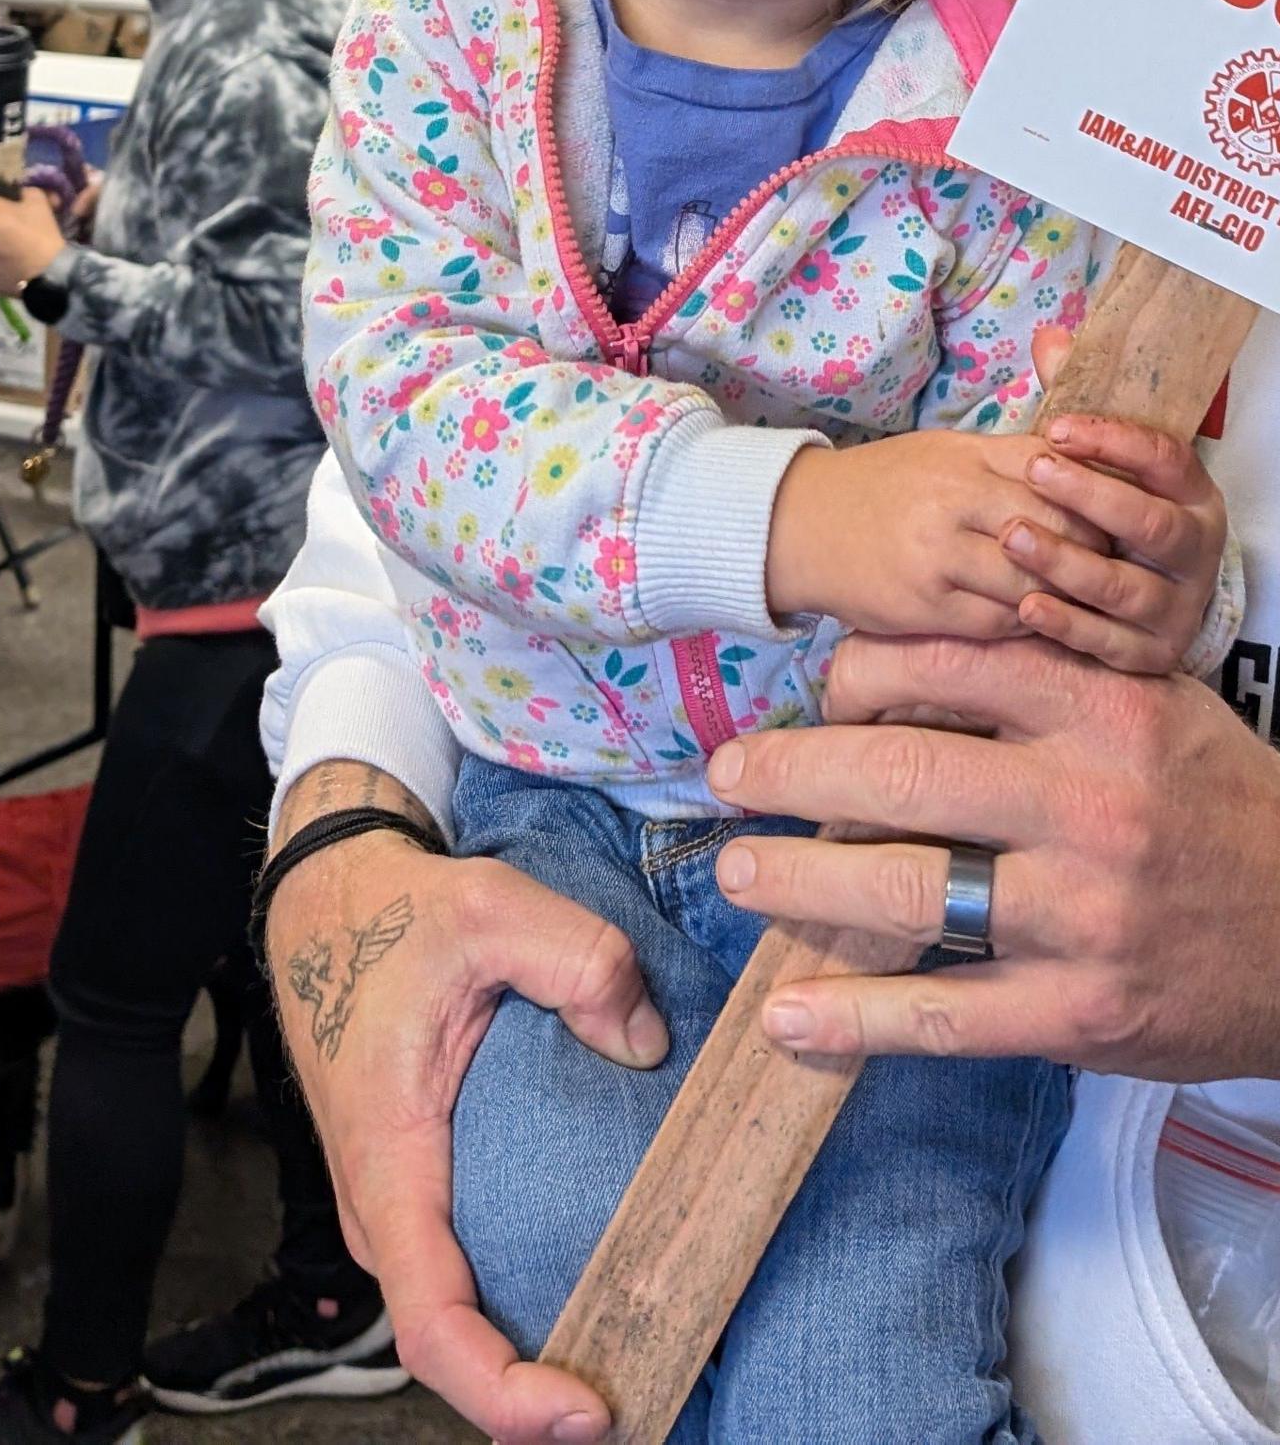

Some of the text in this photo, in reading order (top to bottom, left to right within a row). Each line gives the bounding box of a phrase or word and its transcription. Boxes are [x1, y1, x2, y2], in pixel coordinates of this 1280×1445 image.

[1078, 109, 1178, 172] IAM&AW
[1173, 154, 1280, 220] DISTRICT
[1170, 190, 1265, 252] AFL-CIO
